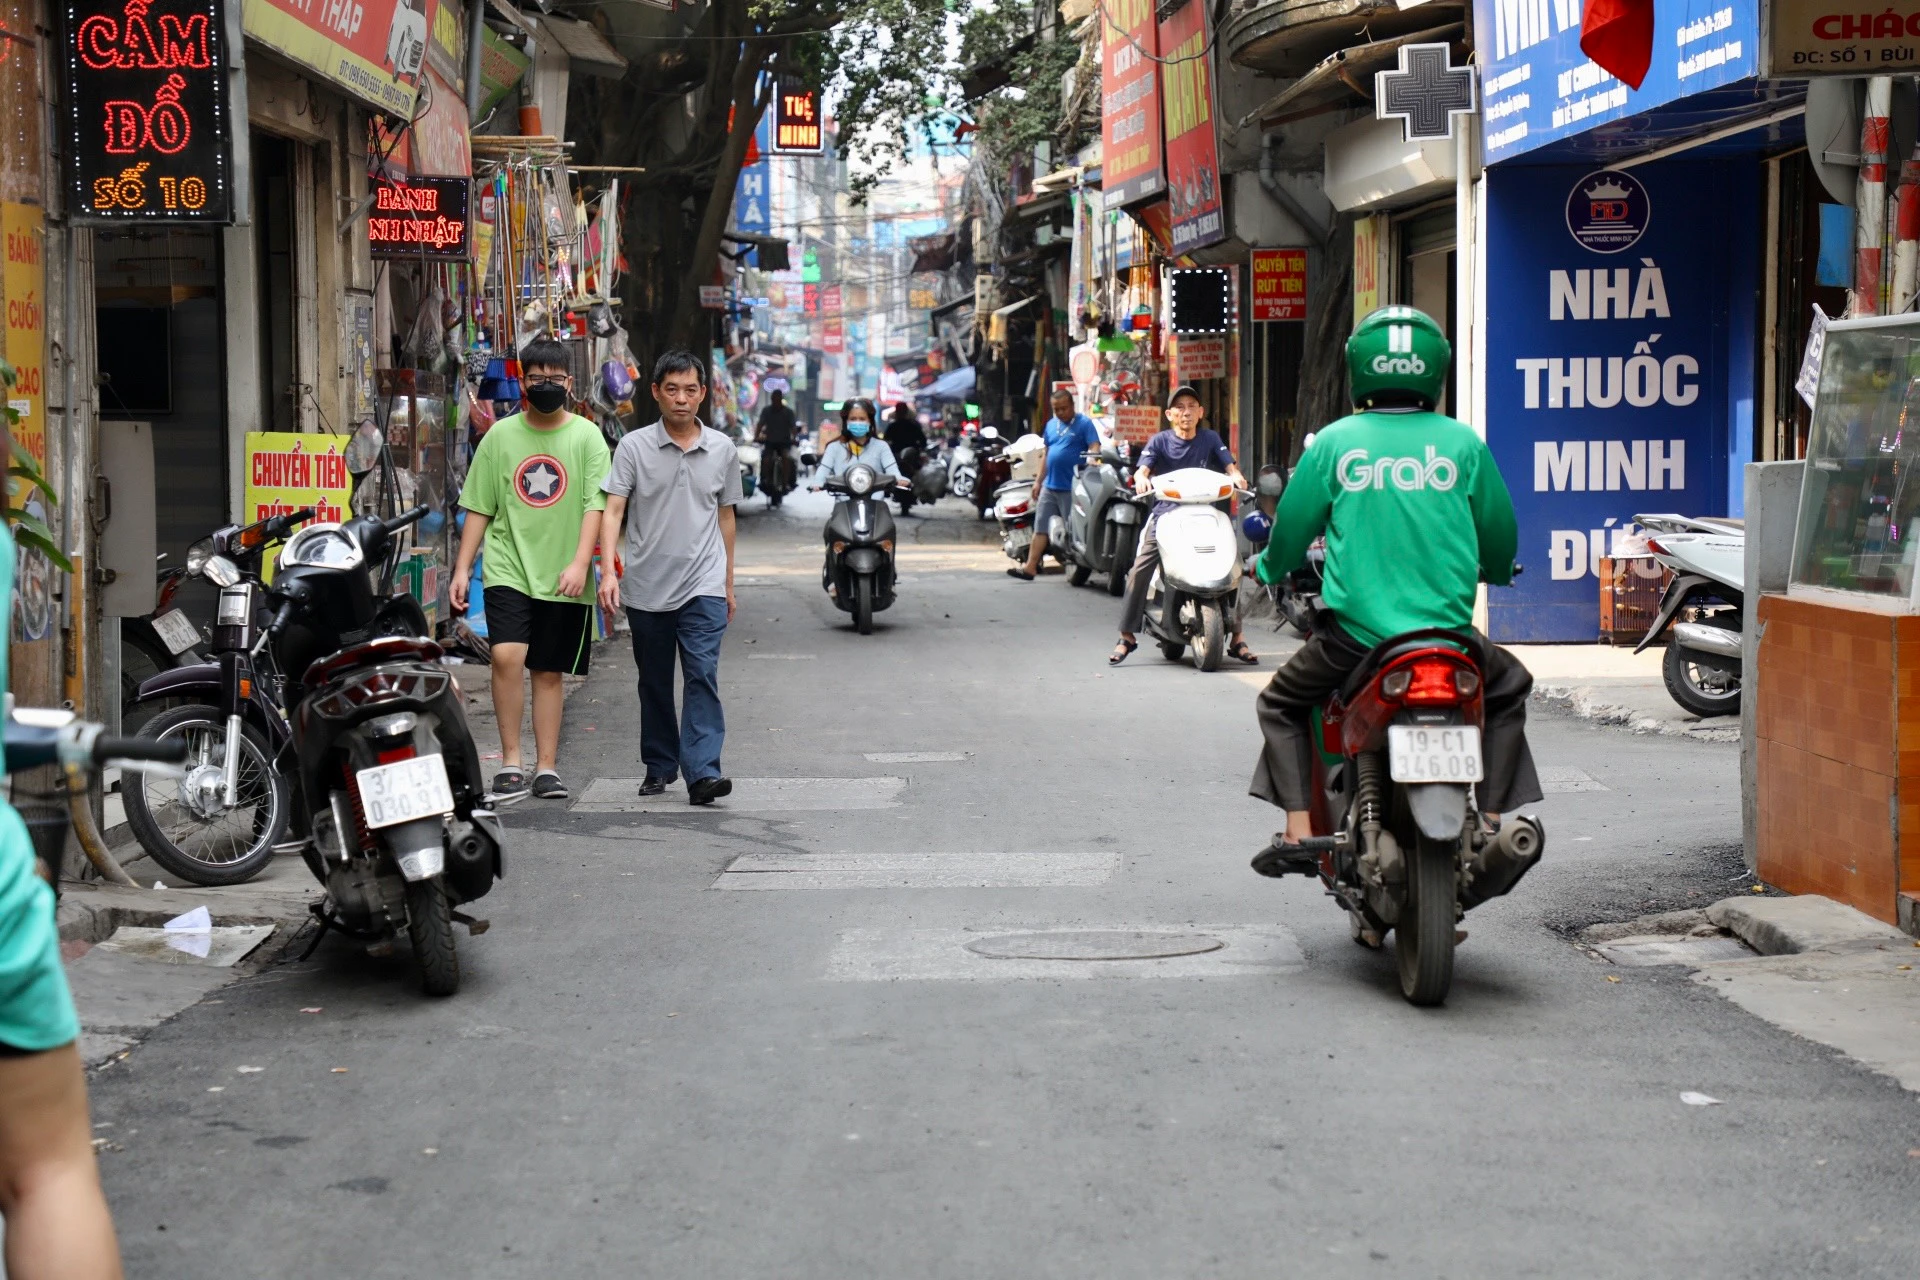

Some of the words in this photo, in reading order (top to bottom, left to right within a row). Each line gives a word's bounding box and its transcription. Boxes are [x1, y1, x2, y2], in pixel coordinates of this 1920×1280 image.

[1792, 50, 1824, 64] ĐC:
[1830, 45, 1857, 63] SỐ
[1864, 49, 1871, 62] 1
[1881, 45, 1914, 61] BÙI
[104, 73, 192, 155] ĐỒ
[779, 124, 818, 146] MINH
[94, 162, 151, 209] SỐ
[159, 177, 206, 209] 10
[8, 226, 39, 265] BÁNH
[403, 214, 464, 248] NHẬT
[1257, 275, 1277, 293] RÚT
[1280, 272, 1302, 293] TIỀN
[1550, 257, 1671, 321] NHÀ
[1268, 307, 1292, 317] 24/7
[15, 366, 40, 395] CAO
[1372, 353, 1426, 375] Grab
[1516, 334, 1699, 409] THUỐC
[252, 441, 311, 488] CHUYỂN
[314, 445, 346, 490] TIỀN
[1336, 445, 1458, 492] Grab
[1534, 439, 1685, 492] MINH
[1406, 730, 1465, 753] 19-C1
